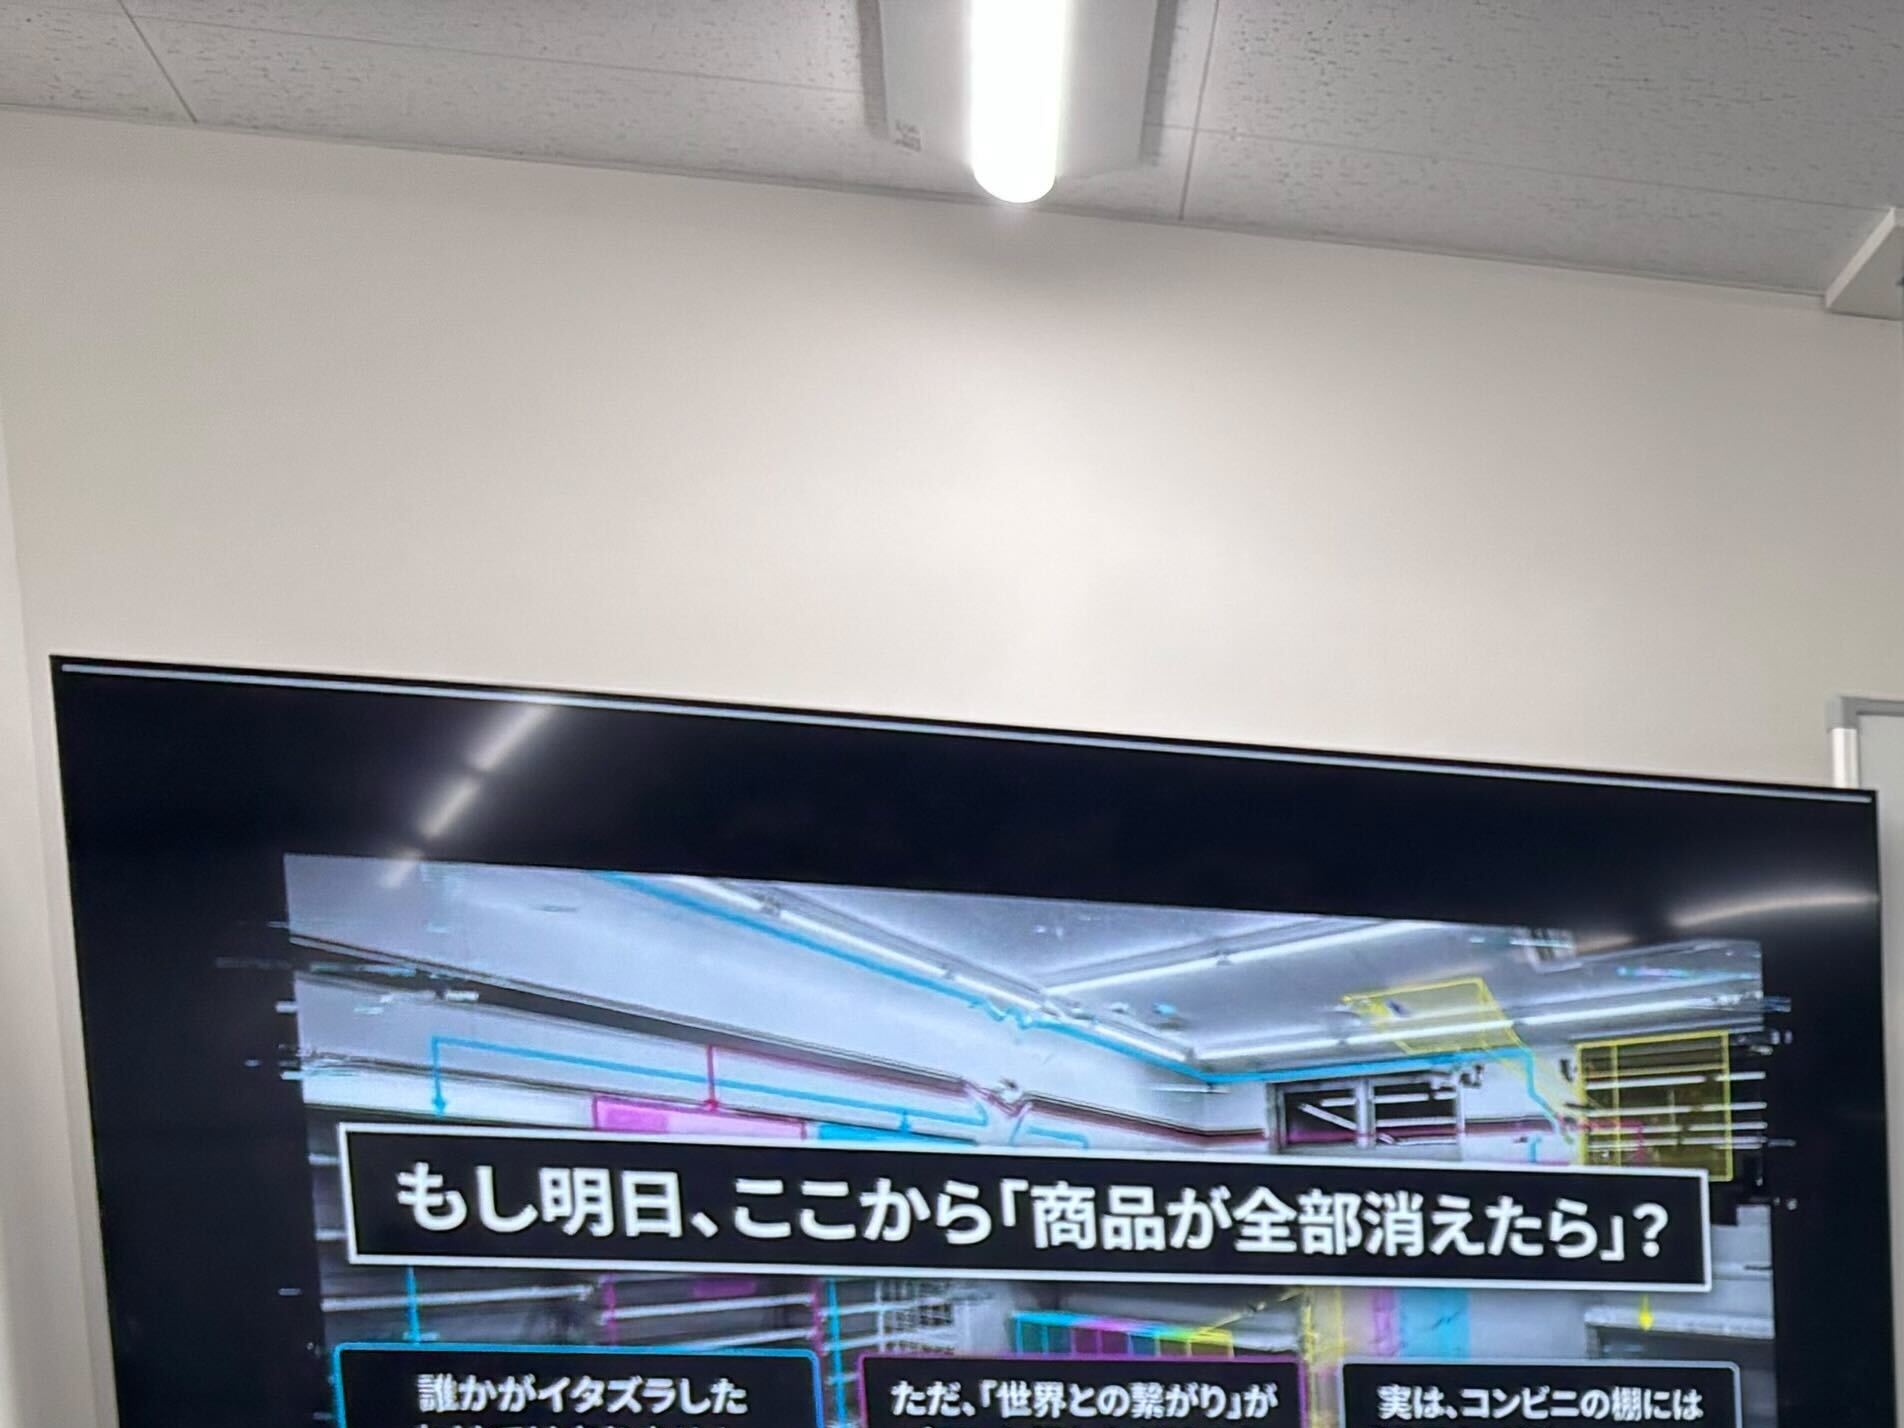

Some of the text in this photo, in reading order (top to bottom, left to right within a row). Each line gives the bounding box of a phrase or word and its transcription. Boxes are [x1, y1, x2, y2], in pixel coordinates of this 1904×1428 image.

[416, 1372, 748, 1416] 誰かがイタズラした
[890, 1379, 1278, 1421] ただ、「世界との繋がり」が
[1377, 1383, 1704, 1422] 実は、コンビニの棚には
